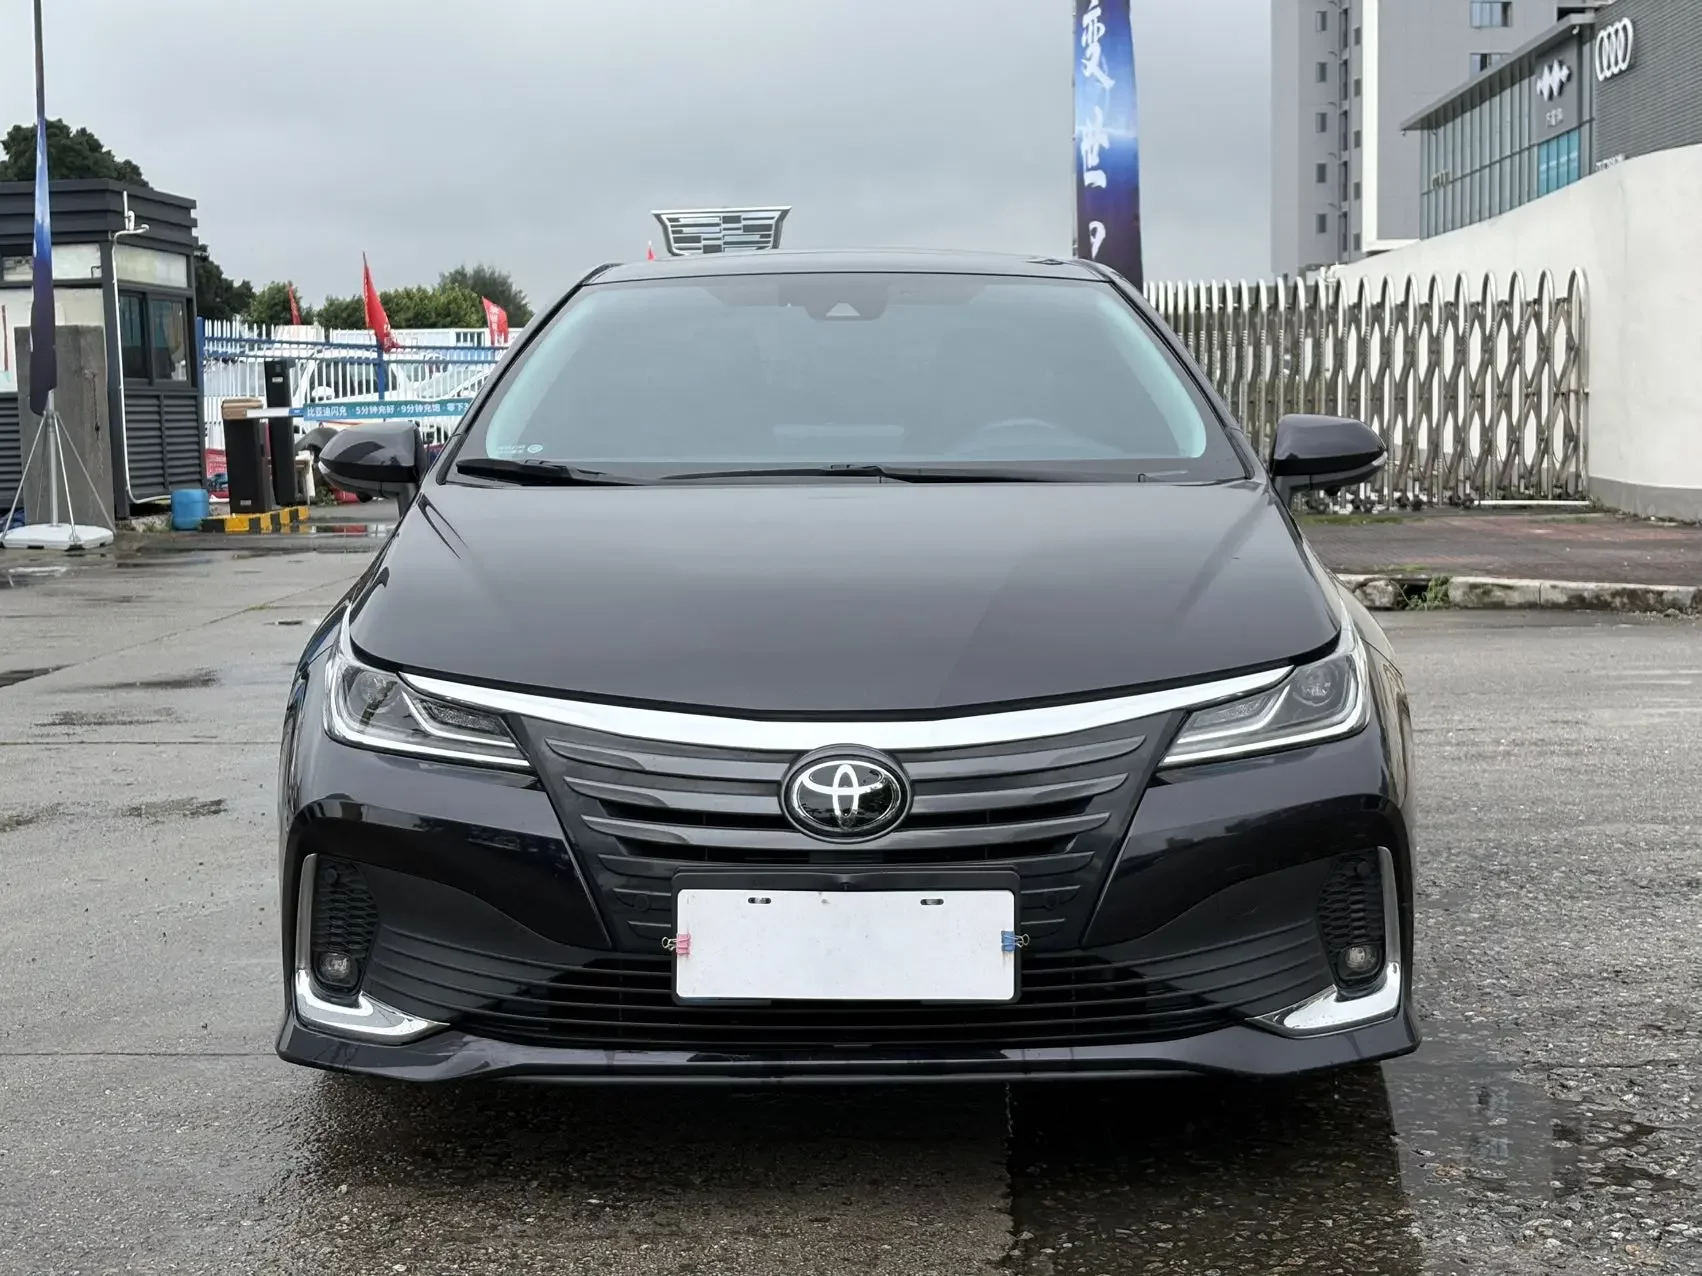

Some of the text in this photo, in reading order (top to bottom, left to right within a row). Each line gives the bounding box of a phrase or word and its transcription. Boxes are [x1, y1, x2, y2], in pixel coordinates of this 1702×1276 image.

[307, 405, 347, 417] 比亚迪闪充
